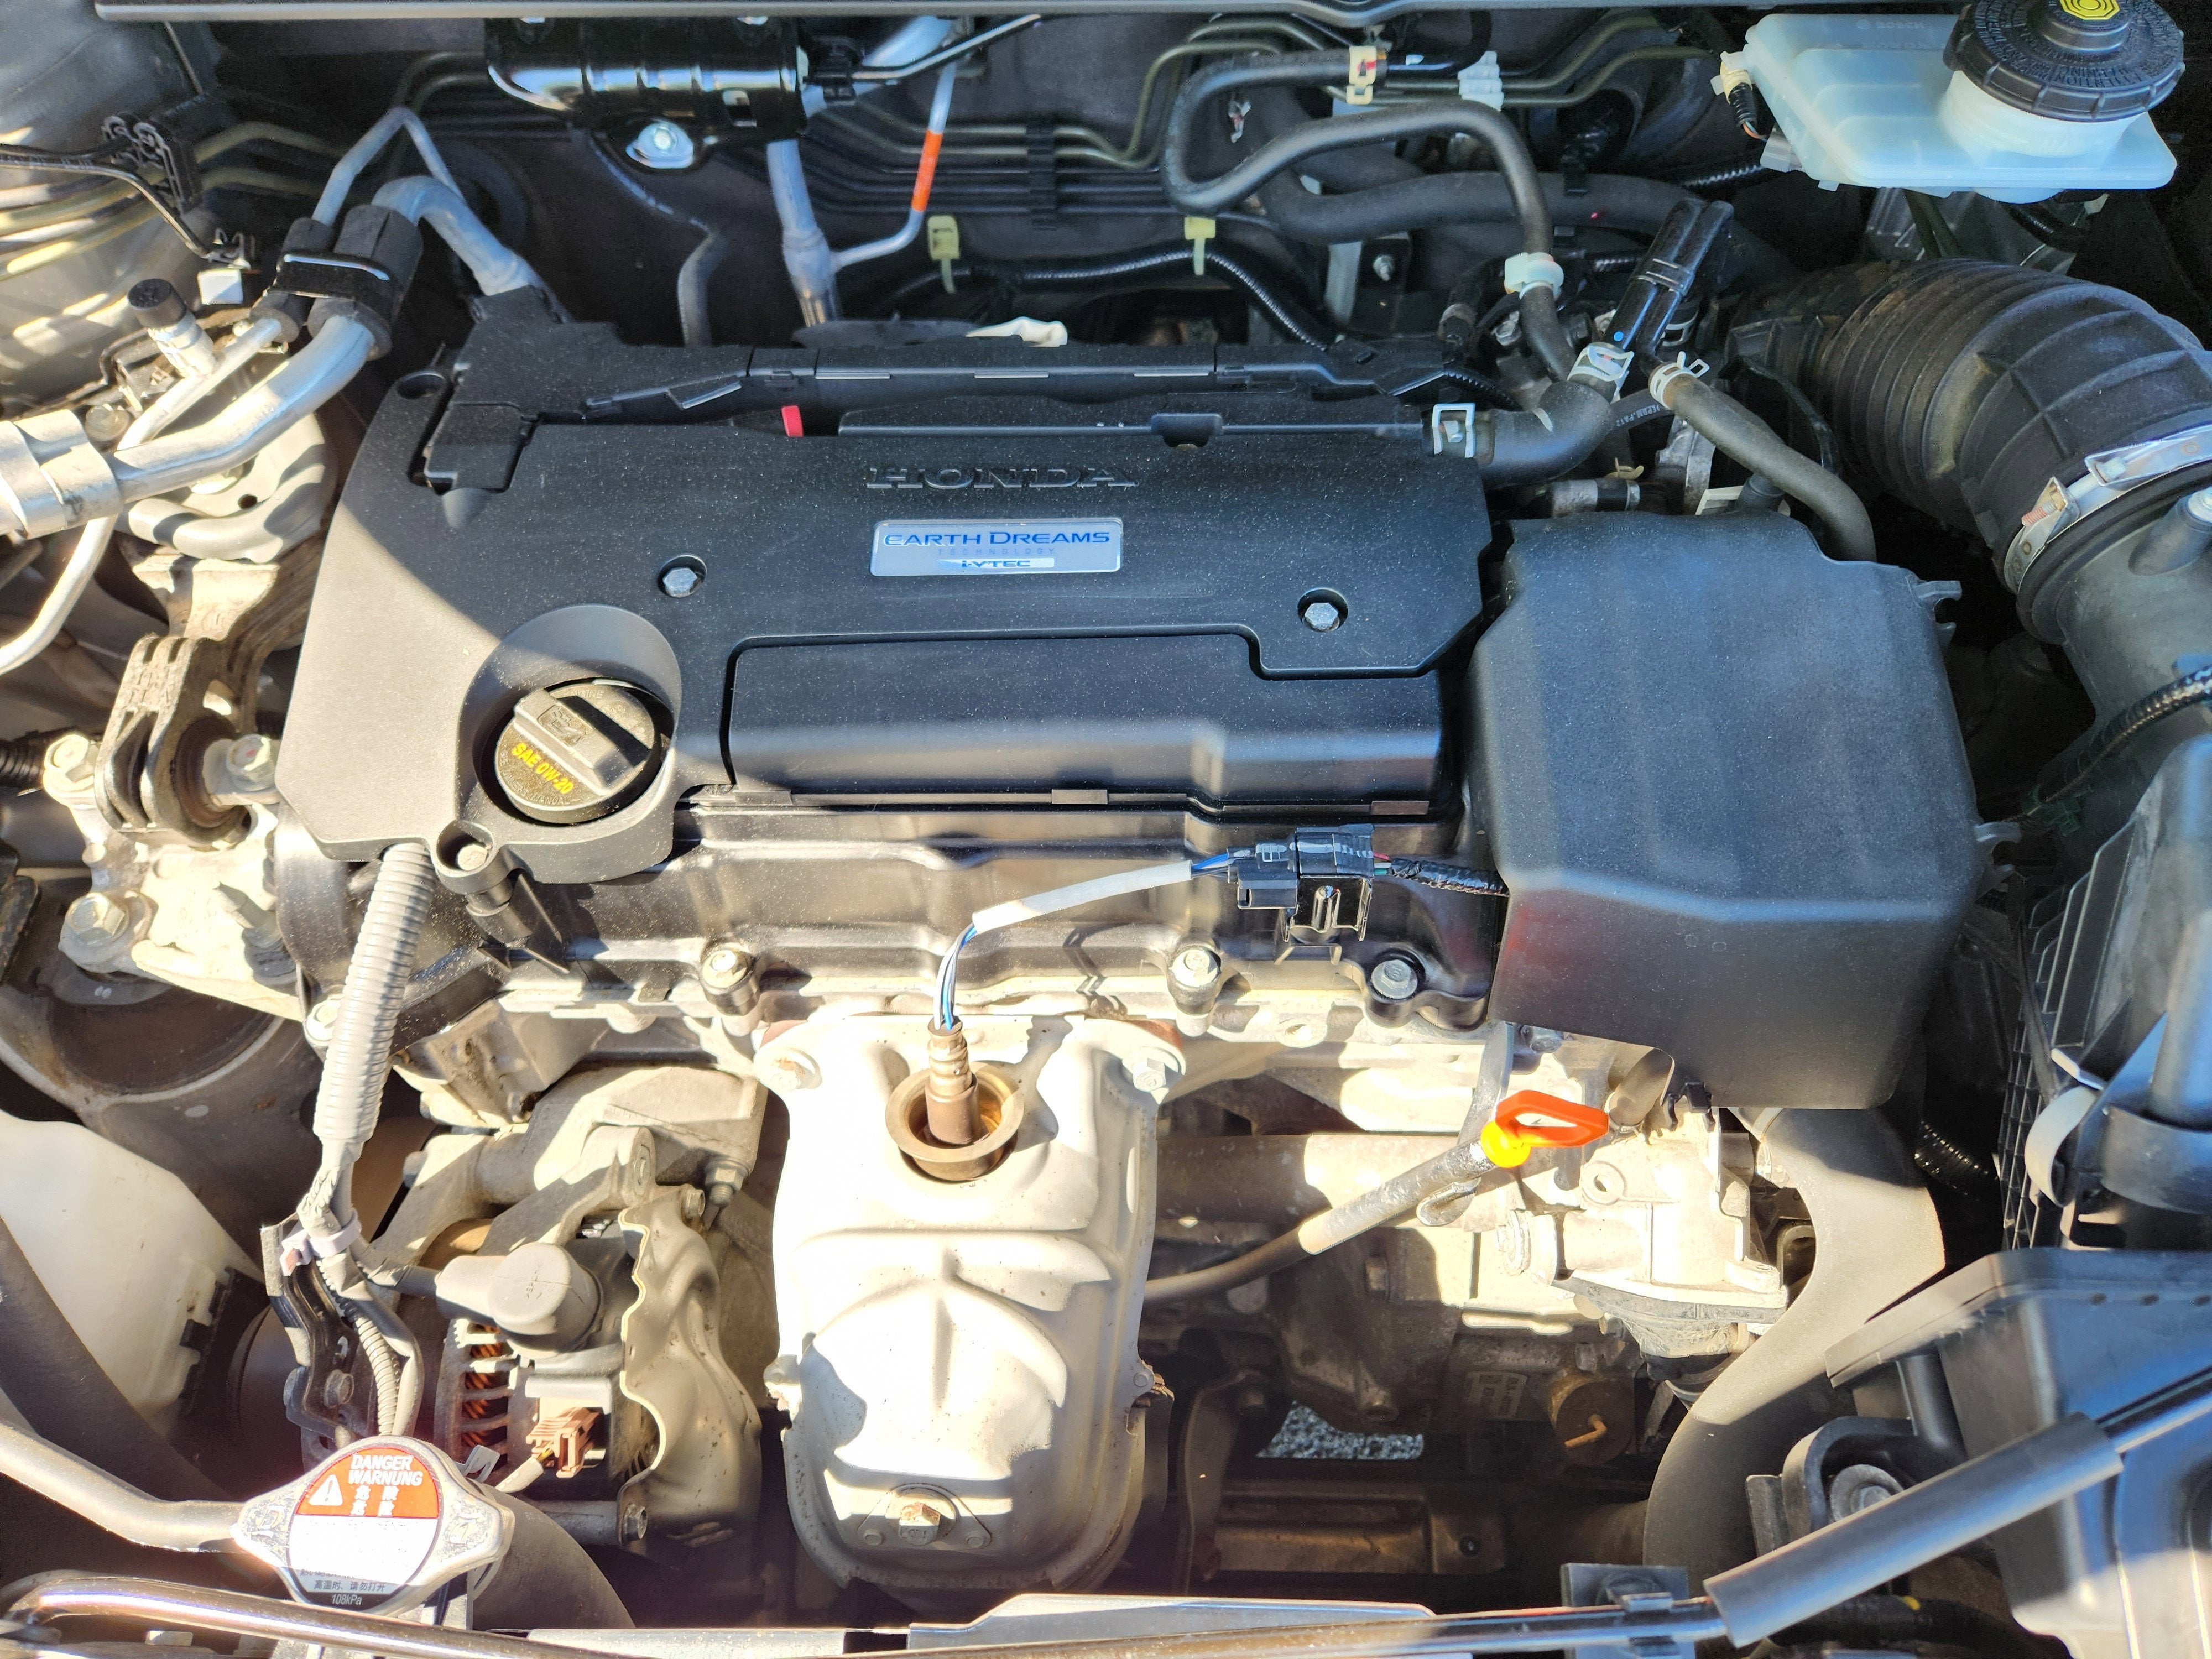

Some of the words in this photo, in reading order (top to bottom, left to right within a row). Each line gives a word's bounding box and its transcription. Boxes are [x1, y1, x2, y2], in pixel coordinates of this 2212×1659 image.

[867, 468, 1138, 488] HONDA
[884, 534, 980, 546] EARTH
[989, 531, 1110, 545] DREAMS
[937, 547, 1056, 556] TECHNOLOGY
[962, 560, 1031, 568] i-VTEC
[512, 743, 540, 768] SAE
[535, 762, 575, 795] 0W-20
[351, 1454, 415, 1470] DANGER
[348, 1470, 424, 1486] WARNUNG
[332, 1594, 362, 1605] 108kPa
